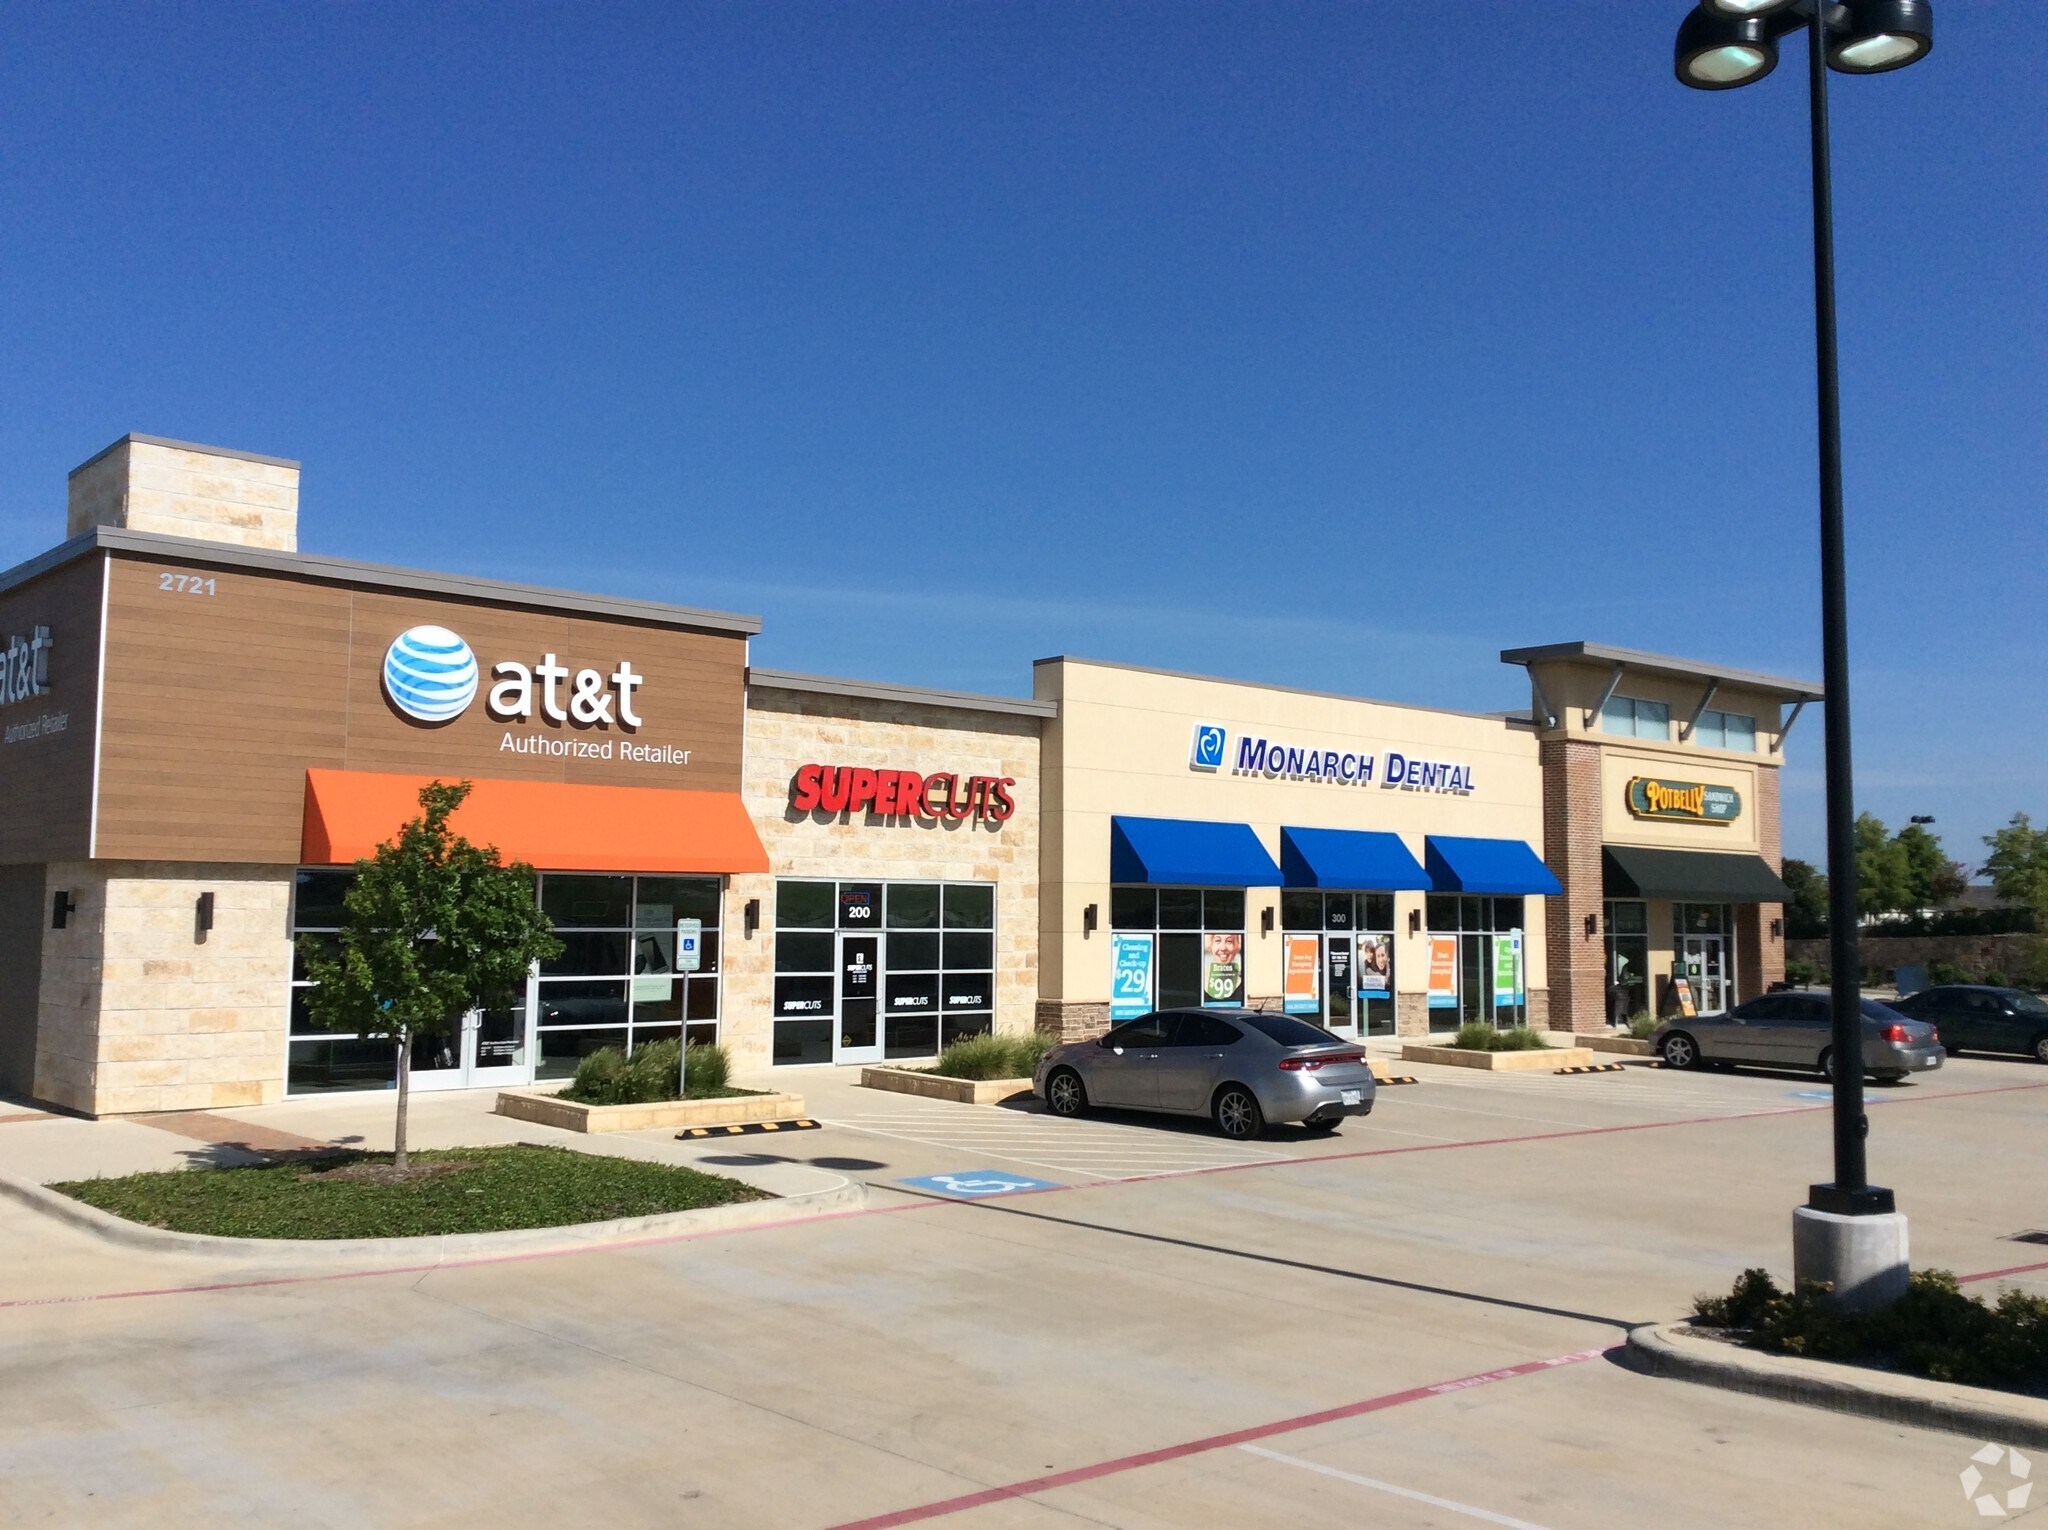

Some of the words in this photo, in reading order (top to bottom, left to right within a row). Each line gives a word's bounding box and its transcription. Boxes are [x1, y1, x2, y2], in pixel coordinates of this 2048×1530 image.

[159, 572, 215, 596] 2721
[489, 653, 643, 727] at&t
[499, 732, 613, 760] Authorized
[619, 741, 692, 765] Retailer
[1238, 736, 1376, 782] MONARCH
[1386, 752, 1476, 791] DENTAL
[794, 763, 1017, 821] SUPERCUTS
[1646, 781, 1706, 816] POTBELLY
[1703, 791, 1734, 803] SANDWICH
[1710, 803, 1728, 814] SHOP
[841, 894, 868, 904] OPEN
[848, 906, 871, 918] 200
[1331, 913, 1347, 923] 300
[1122, 943, 1148, 953] Cleaning
[1128, 952, 1140, 960] and
[1120, 960, 1147, 969] Check-up
[1213, 964, 1233, 972] Braces
[1209, 977, 1234, 998] $99
[783, 1000, 822, 1011] SUPERCUTS
[894, 997, 929, 1007] SUPERCUTS
[949, 995, 982, 1006] SUPERCUTS
